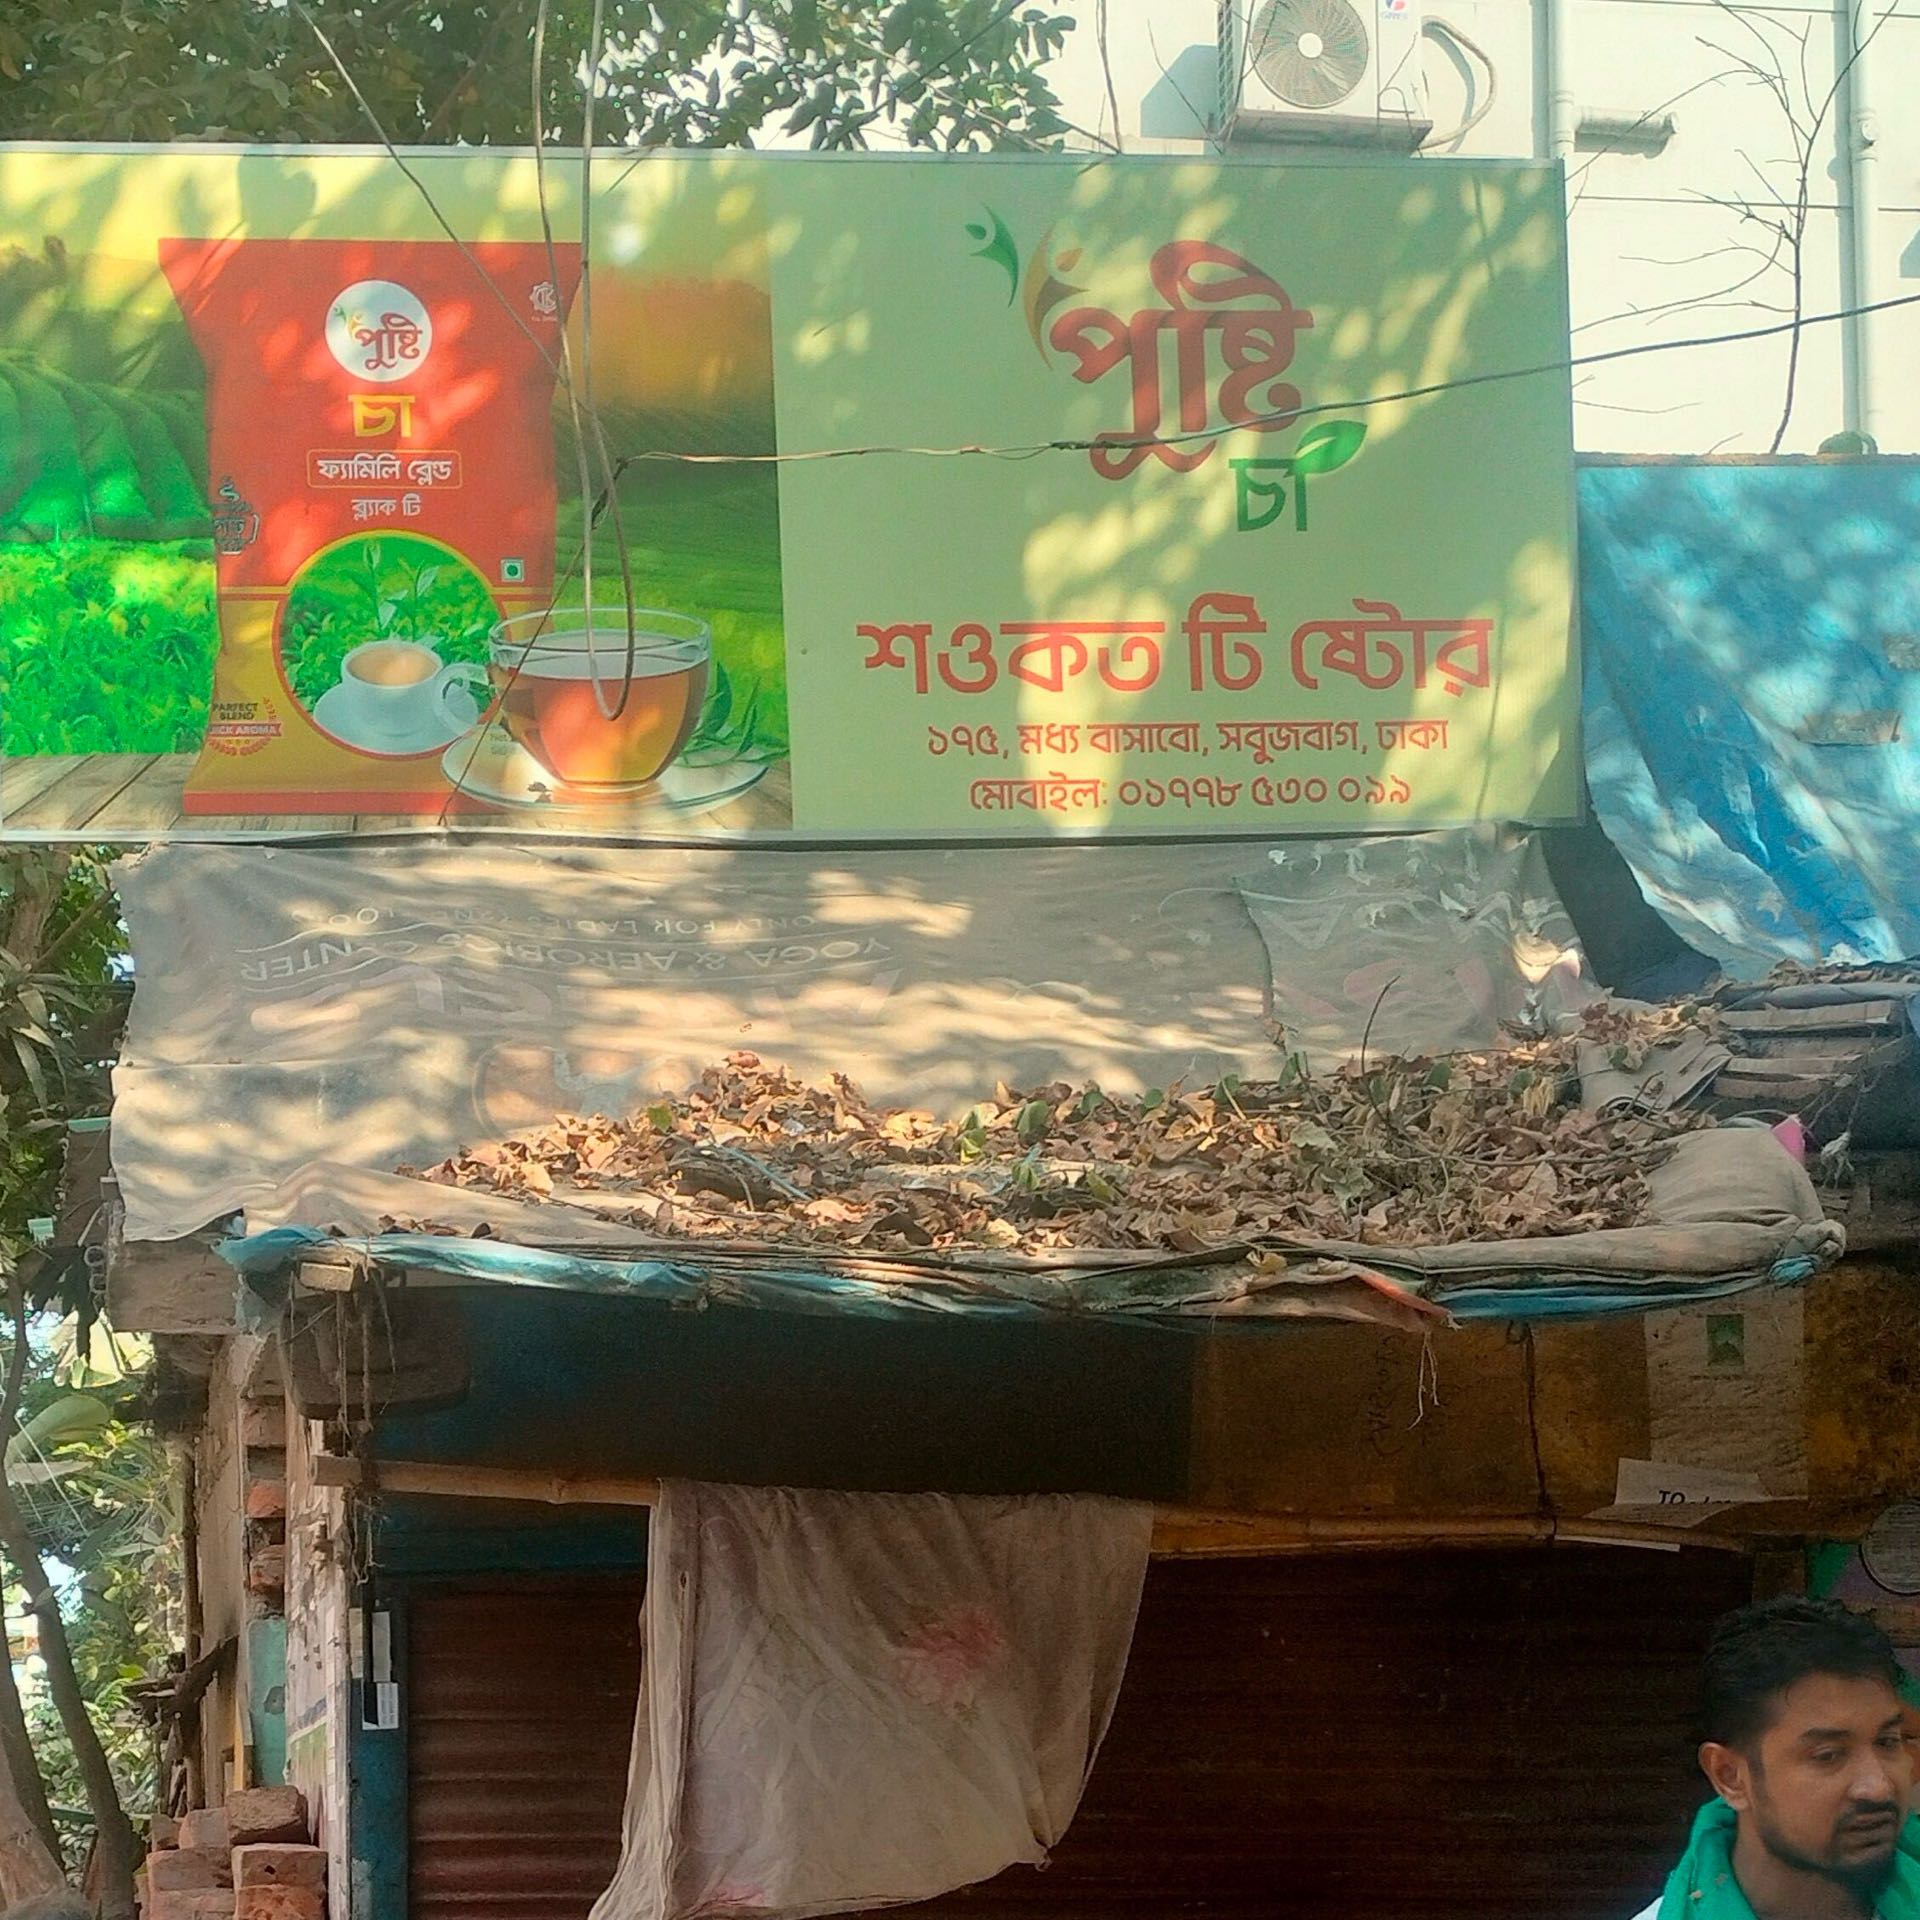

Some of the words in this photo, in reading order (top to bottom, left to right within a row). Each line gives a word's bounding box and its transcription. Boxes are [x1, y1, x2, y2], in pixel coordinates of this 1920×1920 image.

[355, 312, 423, 371] পুষ্টি
[1050, 239, 1314, 481] পুষ্টি
[348, 394, 416, 438] চা
[317, 453, 402, 480] ফ্যামিলি
[402, 493, 421, 517] টি
[856, 621, 1165, 694] শওকত
[1181, 592, 1267, 691] টি
[1291, 598, 1494, 697] ষ্টোর
[219, 711, 255, 721] BLEND
[928, 724, 1008, 759] ১৭৫,
[1016, 723, 1080, 754] মধ্য
[1087, 722, 1209, 757] বাসাবো,
[1216, 720, 1368, 764] সবুজবাগ,
[1375, 720, 1448, 750] ঢাকা
[1118, 776, 1243, 808] ০১৭৭৮
[1252, 776, 1328, 806] ৫৩০
[1338, 774, 1411, 804] ০৯৯
[653, 918, 716, 936] FOR
[744, 936, 892, 969] YOGA
